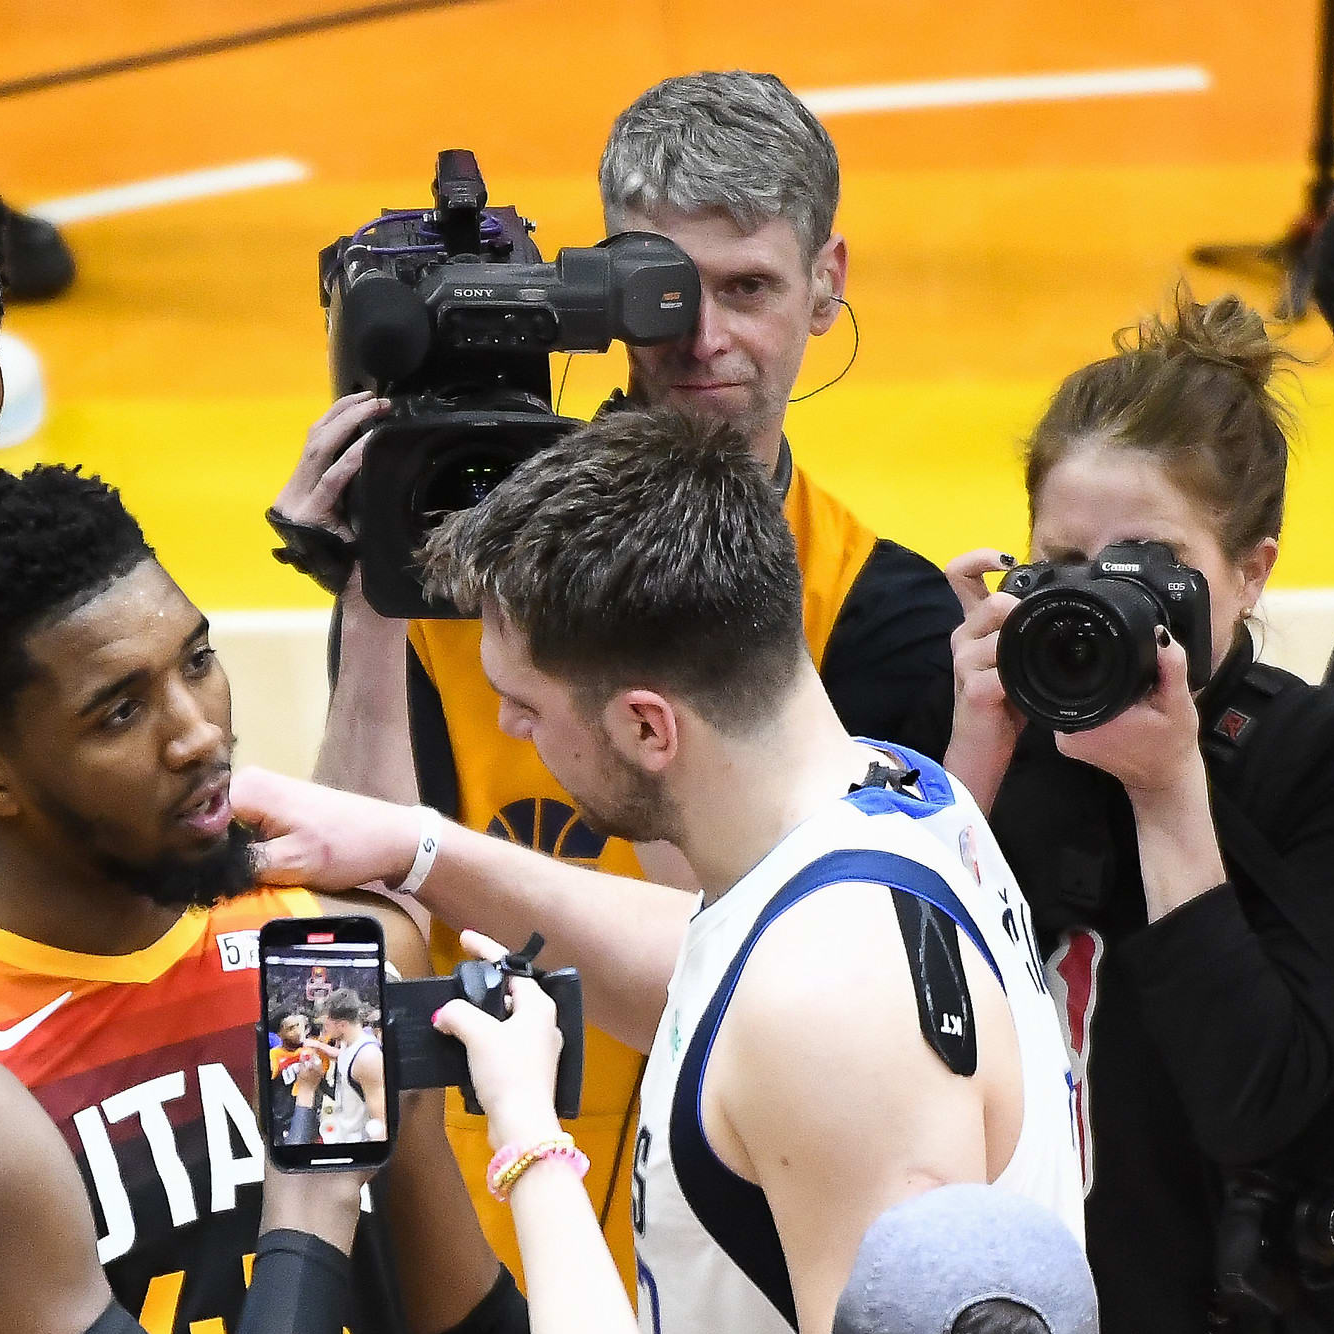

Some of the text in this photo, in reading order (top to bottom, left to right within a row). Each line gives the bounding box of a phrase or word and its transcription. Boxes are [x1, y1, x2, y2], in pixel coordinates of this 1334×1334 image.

[453, 288, 494, 298] SONY
[1101, 562, 1140, 572] Canon
[1168, 582, 1186, 591] EOS
[940, 1012, 963, 1037] KT
